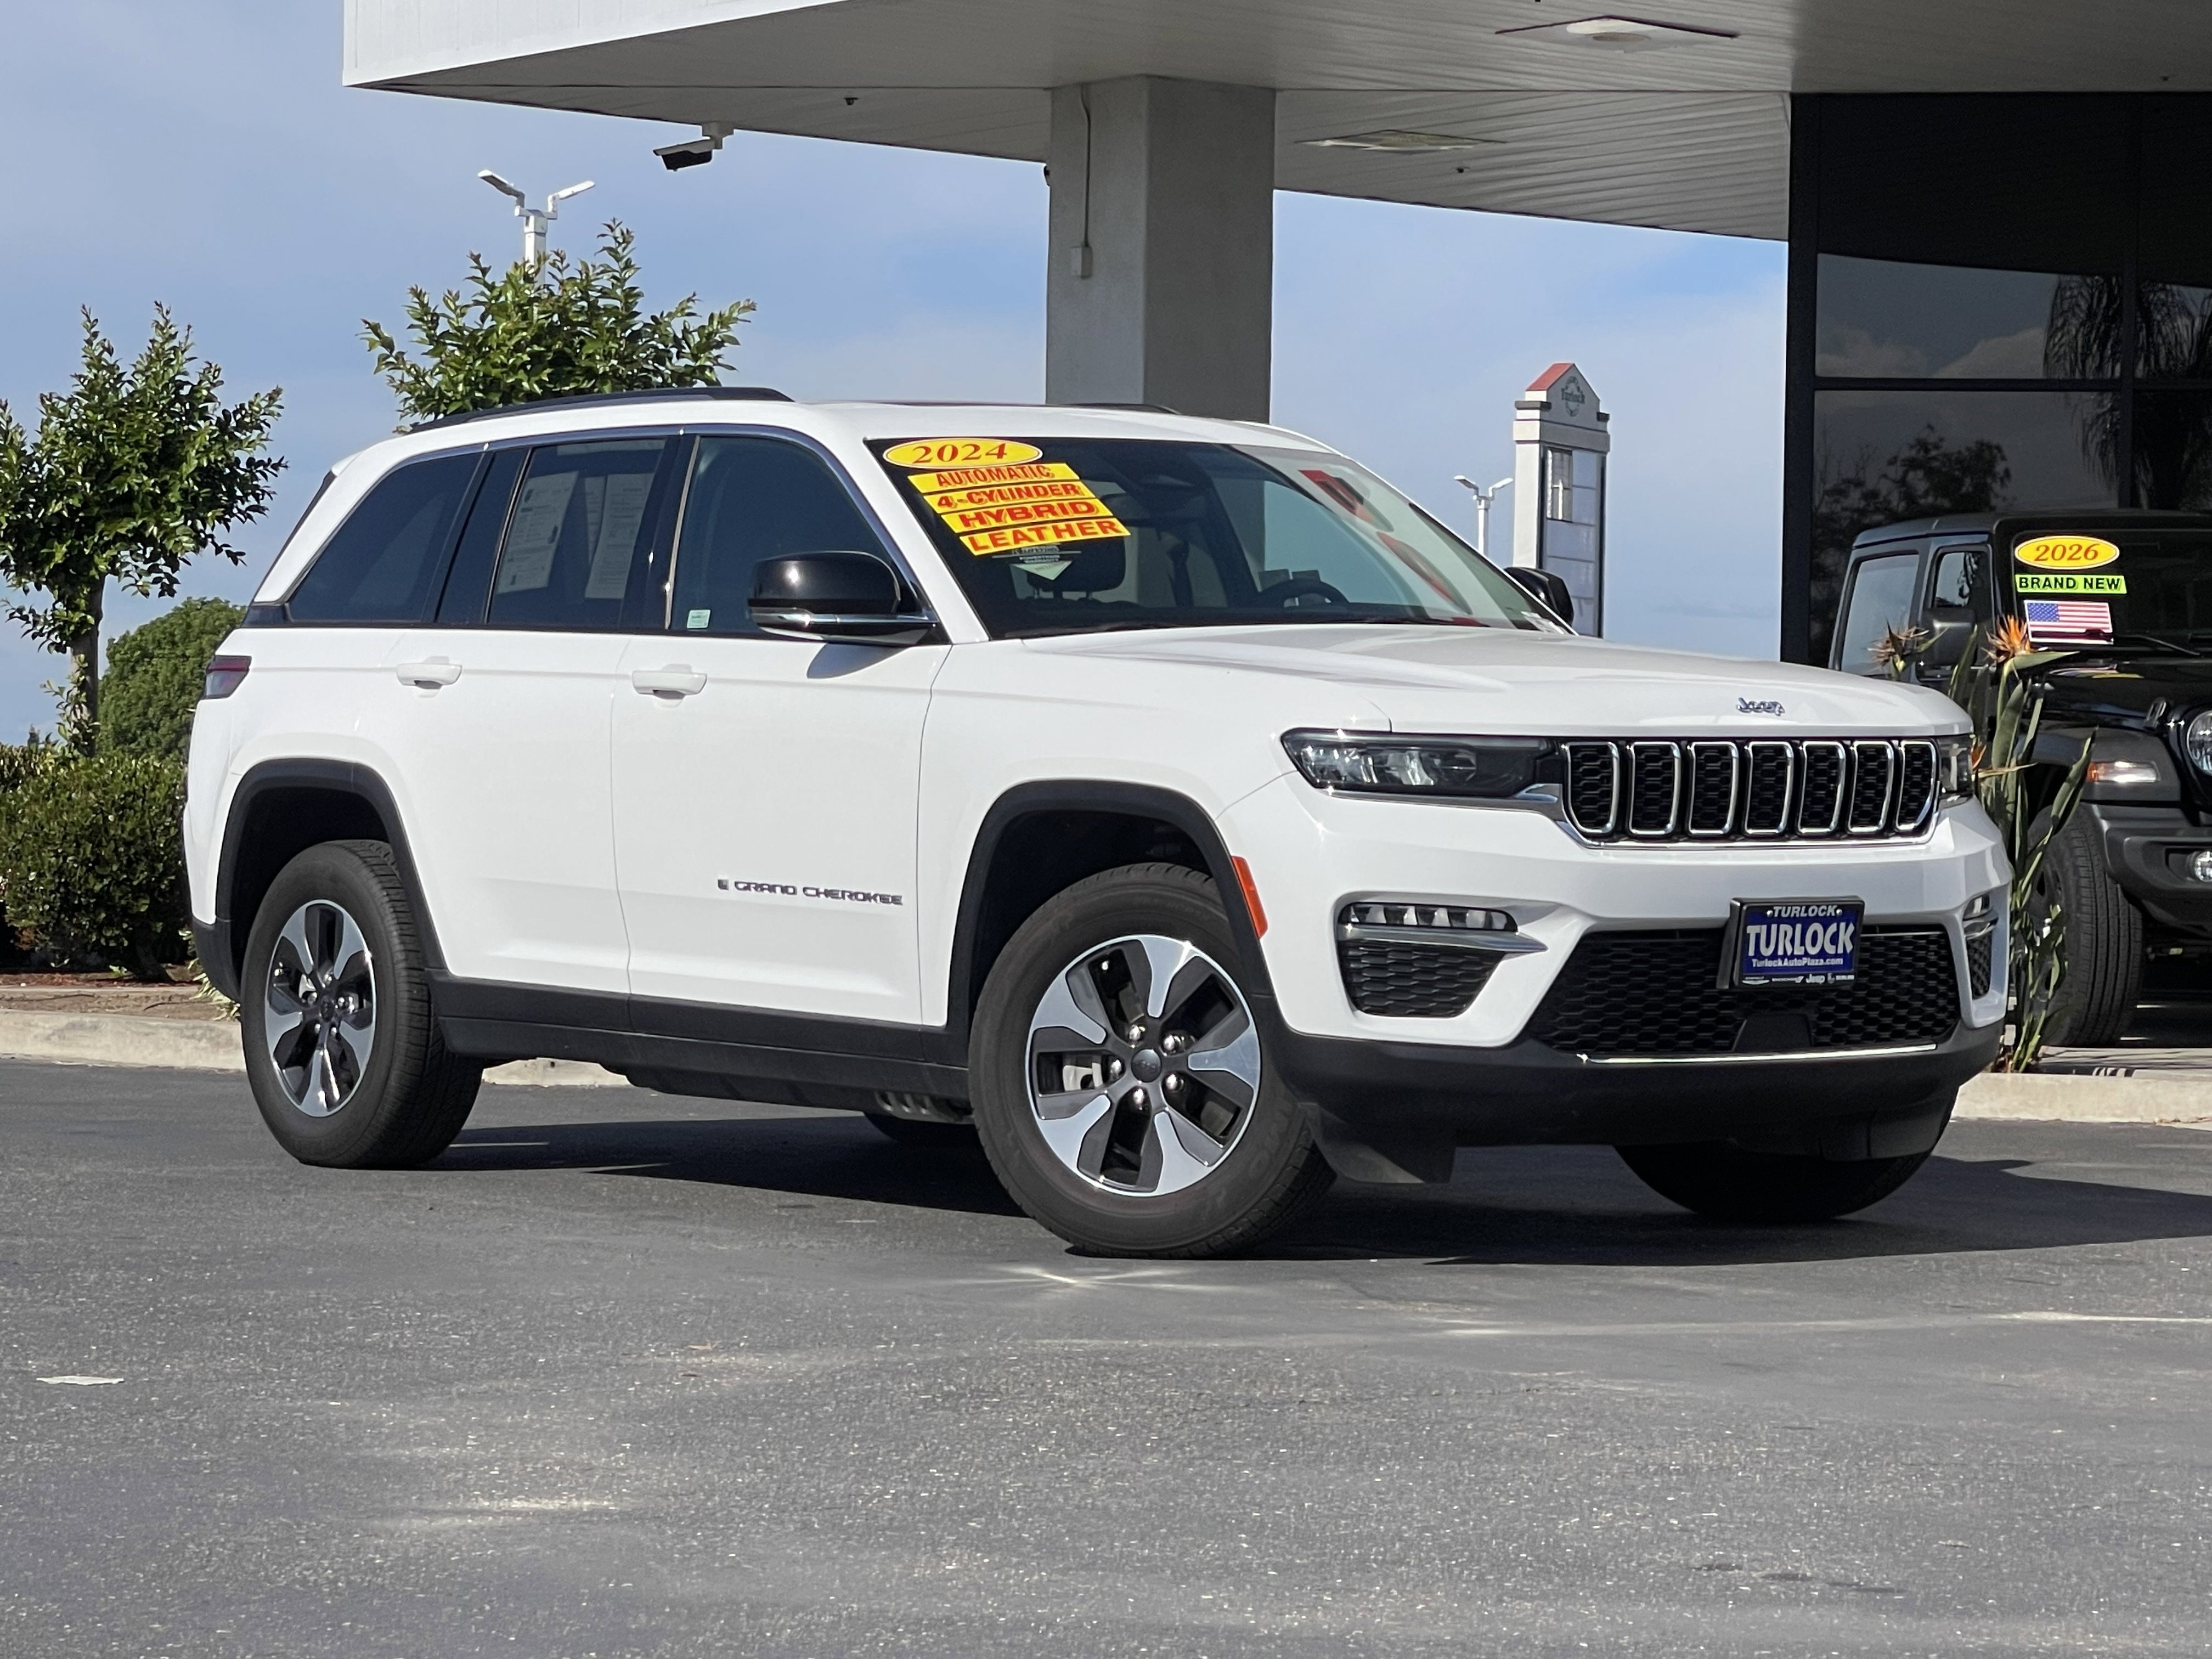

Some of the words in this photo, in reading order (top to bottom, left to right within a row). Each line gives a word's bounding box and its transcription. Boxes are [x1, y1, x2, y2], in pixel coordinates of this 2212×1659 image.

[912, 443, 1008, 464] 2024
[936, 464, 1053, 487] AUTOMATIC
[937, 483, 1081, 509] 4-CYLINDER
[958, 501, 1098, 527] HYBRID
[967, 520, 1125, 551] LEATHER
[2034, 544, 2100, 561] 2026
[2019, 577, 2076, 589] BRAND
[2084, 578, 2121, 590] NEW
[1736, 697, 1785, 716] Jeep
[735, 881, 797, 895] GRAND
[803, 887, 903, 905] CHEROKEE
[1773, 905, 1837, 917] TURLOCK
[1746, 922, 1855, 956] TURLOCK
[1752, 958, 1843, 967] TurlockAutoPlaza.com
[1806, 974, 1825, 984] Jeep
